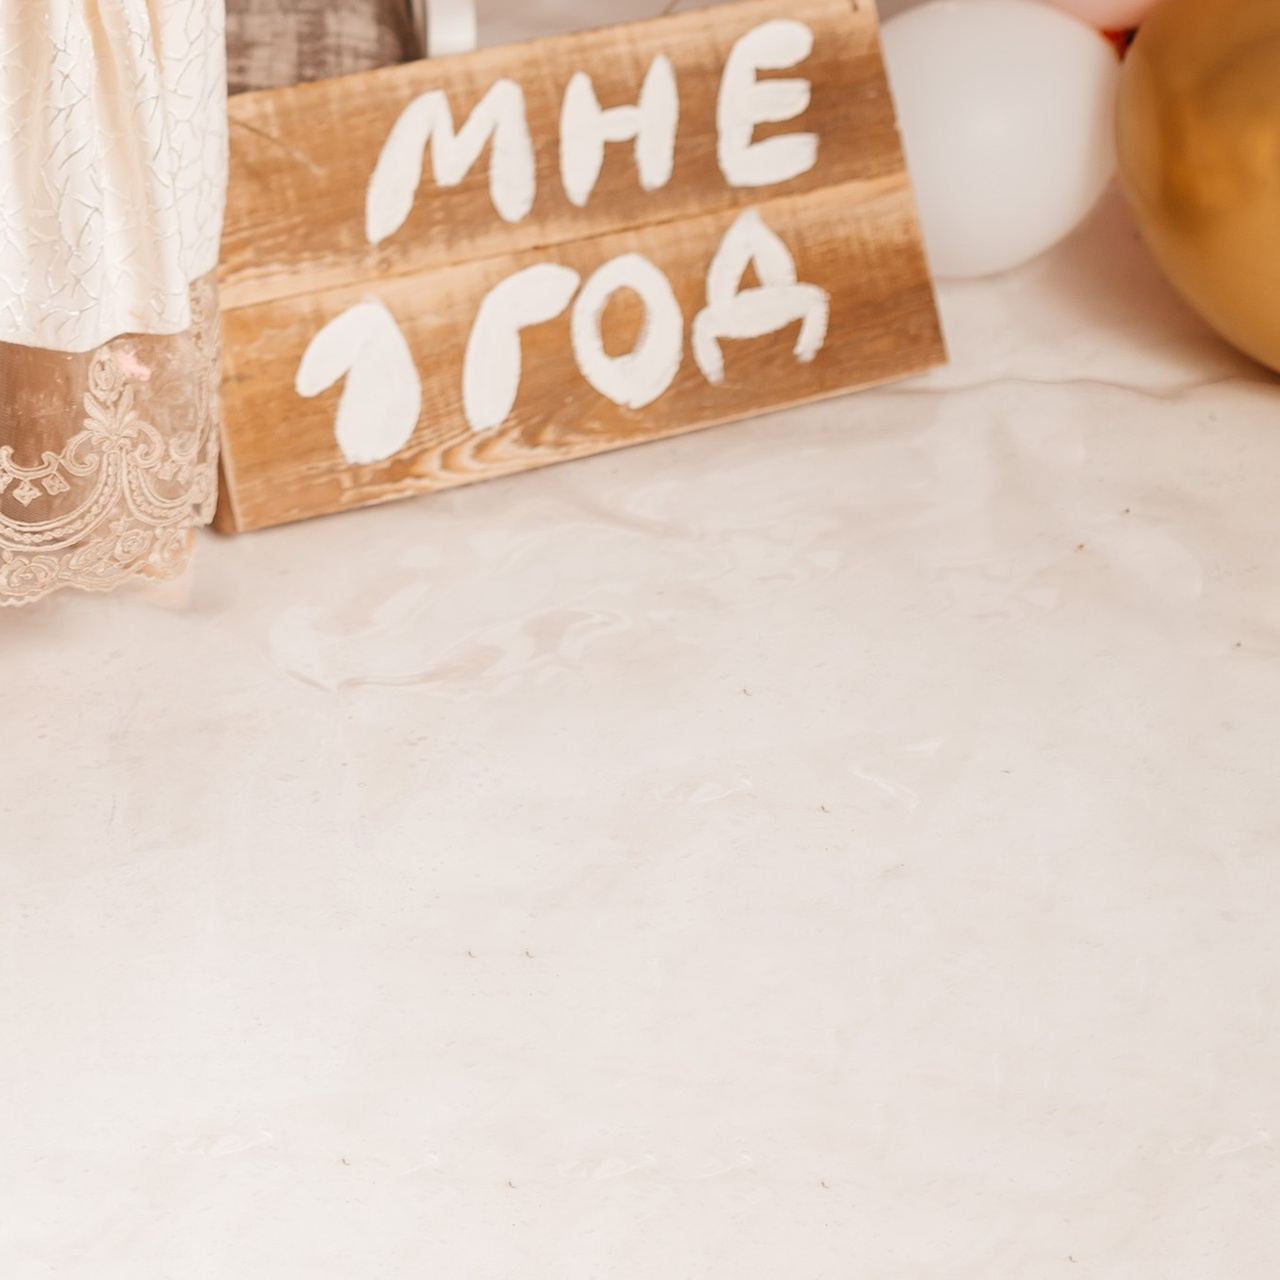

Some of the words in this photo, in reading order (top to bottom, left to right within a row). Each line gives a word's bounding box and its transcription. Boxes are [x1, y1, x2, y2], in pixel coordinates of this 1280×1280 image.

[365, 18, 819, 244] МНЕ
[294, 295, 422, 465] 1
[462, 207, 830, 433] ГОД
